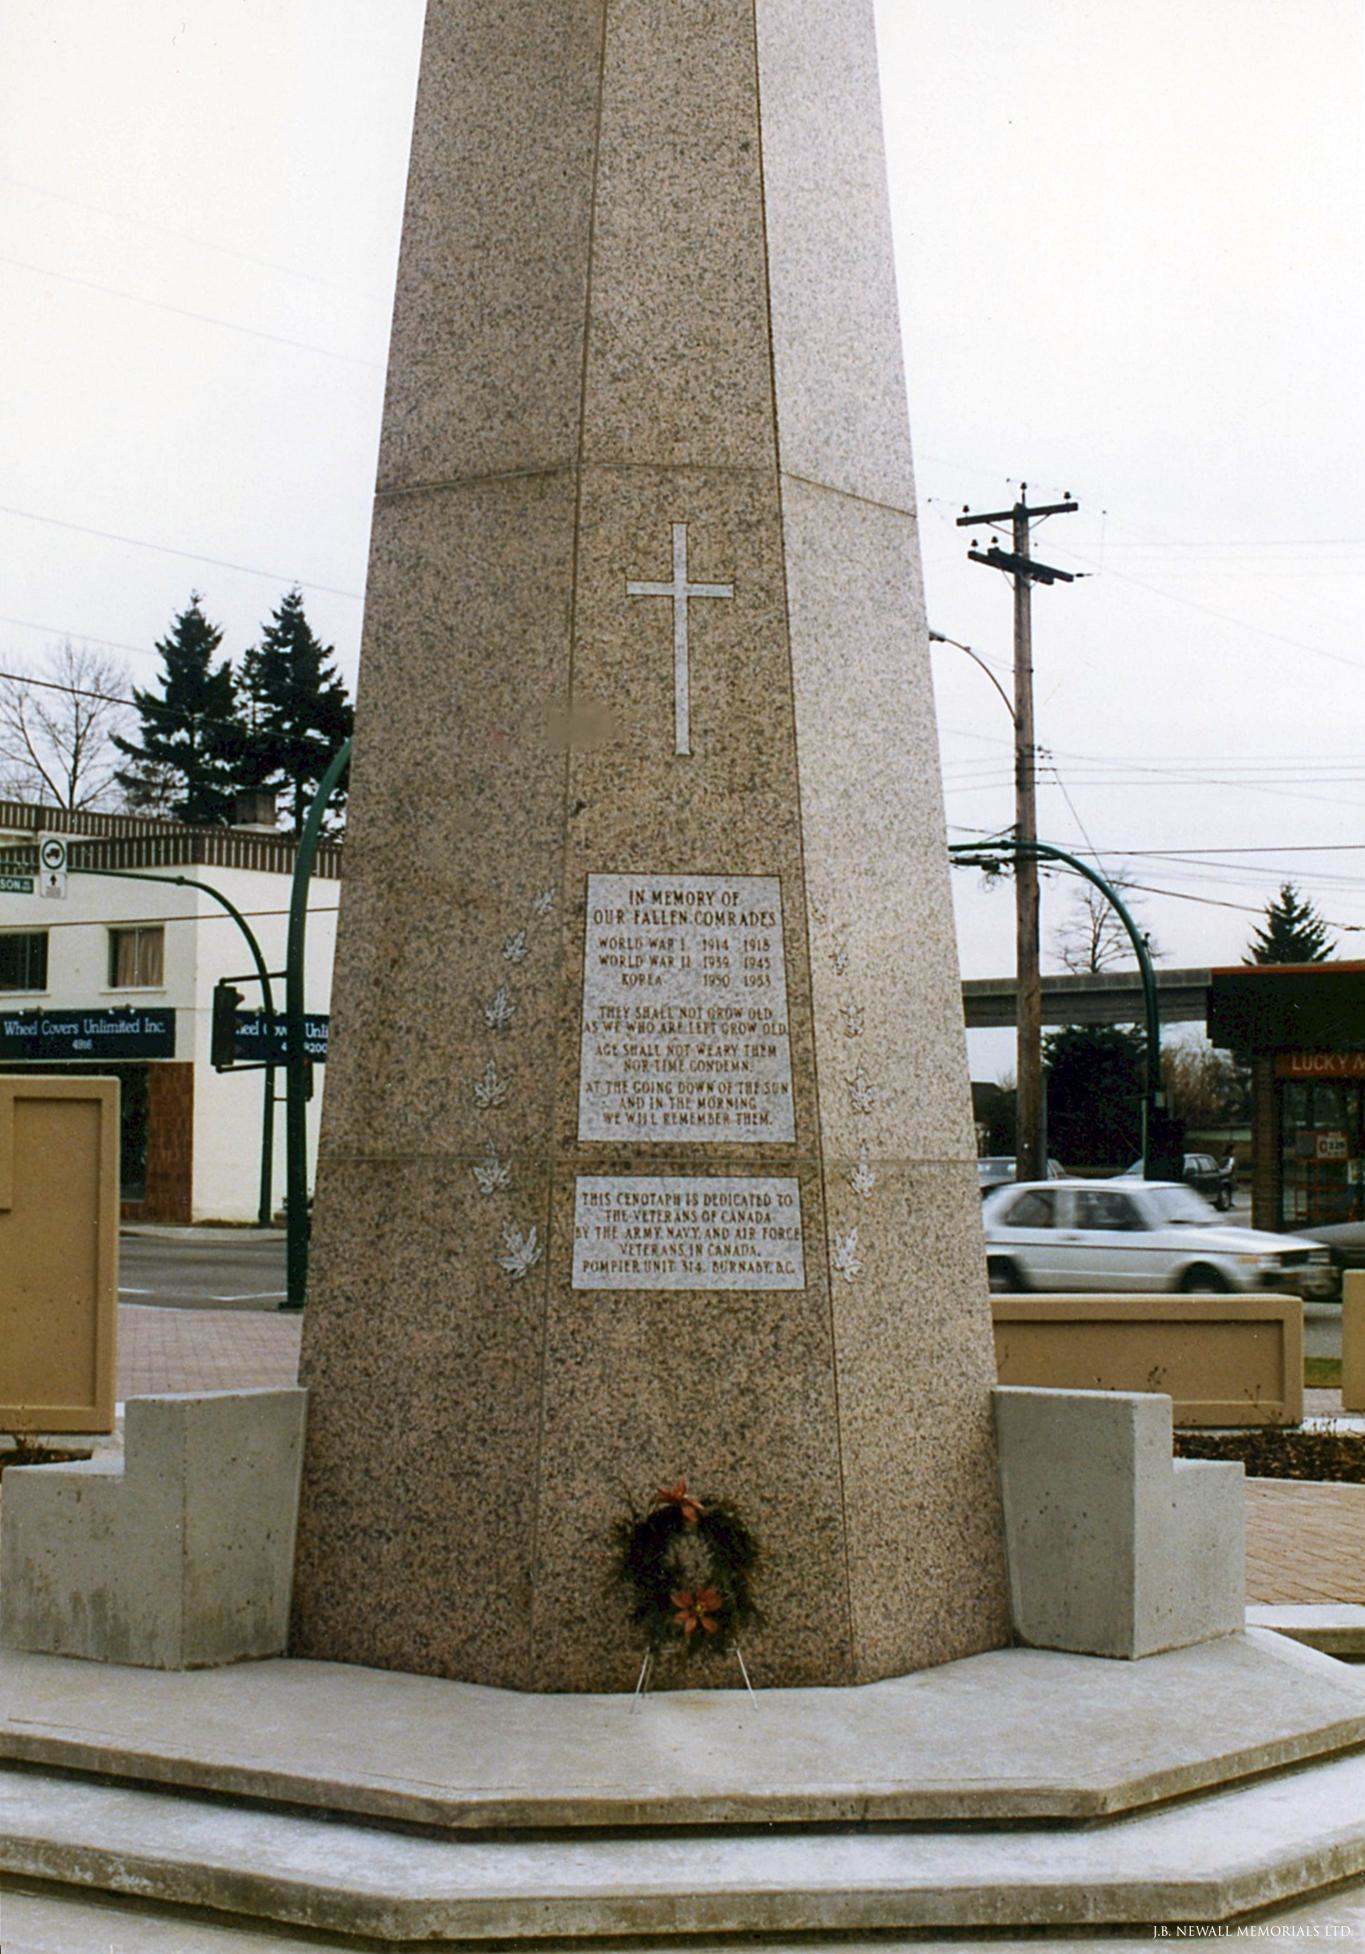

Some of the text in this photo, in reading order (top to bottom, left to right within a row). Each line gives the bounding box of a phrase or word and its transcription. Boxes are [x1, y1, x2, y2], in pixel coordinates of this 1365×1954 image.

[629, 890, 740, 907] IN MEMORY OF
[593, 910, 777, 926] OUR FALLEN COMRADES
[599, 938, 771, 952] WORLD WAR I 1914 1918
[599, 956, 771, 970] WORLD WAR II 1939 1945
[621, 974, 772, 988] KOREA 1950 1953
[599, 1006, 773, 1021] THEY SHALL NOT GROW OLD
[4, 1017, 166, 1036] Wheel Covers Unlimited Inc.
[584, 1021, 598, 1034] AS
[603, 1021, 620, 1034] WE
[627, 1021, 655, 1034] WHO
[661, 1021, 683, 1034] ARE
[689, 1022, 716, 1035] LEFT
[721, 1022, 757, 1035] GROW
[595, 1044, 776, 1057] AGE SHALL NOT WEARY THEM
[624, 1059, 649, 1073] NOR
[654, 1059, 685, 1073] TIME
[1292, 1055, 1345, 1071] LUCKY
[586, 1081, 789, 1094] AT THE GOING DOWN OF THE SUN
[619, 1097, 645, 1110] AND
[650, 1097, 663, 1110] IN
[669, 1097, 690, 1110] THE
[603, 1112, 621, 1125] WE
[626, 1112, 657, 1125] WILL
[663, 1112, 730, 1125] REMEMBER
[582, 1192, 793, 1208] THIS CENOTAPH IS DEDICATED TO
[604, 1209, 628, 1222] THE
[632, 1209, 697, 1222] VETERANS
[702, 1210, 717, 1223] OF
[575, 1226, 589, 1240] BY
[596, 1226, 618, 1240] THE
[705, 1226, 729, 1240] AND
[735, 1226, 756, 1240] AIR
[762, 1227, 801, 1241] FORCE
[619, 1243, 685, 1256] VETERANS
[689, 1243, 703, 1256] IN
[644, 1260, 675, 1273] UNIT
